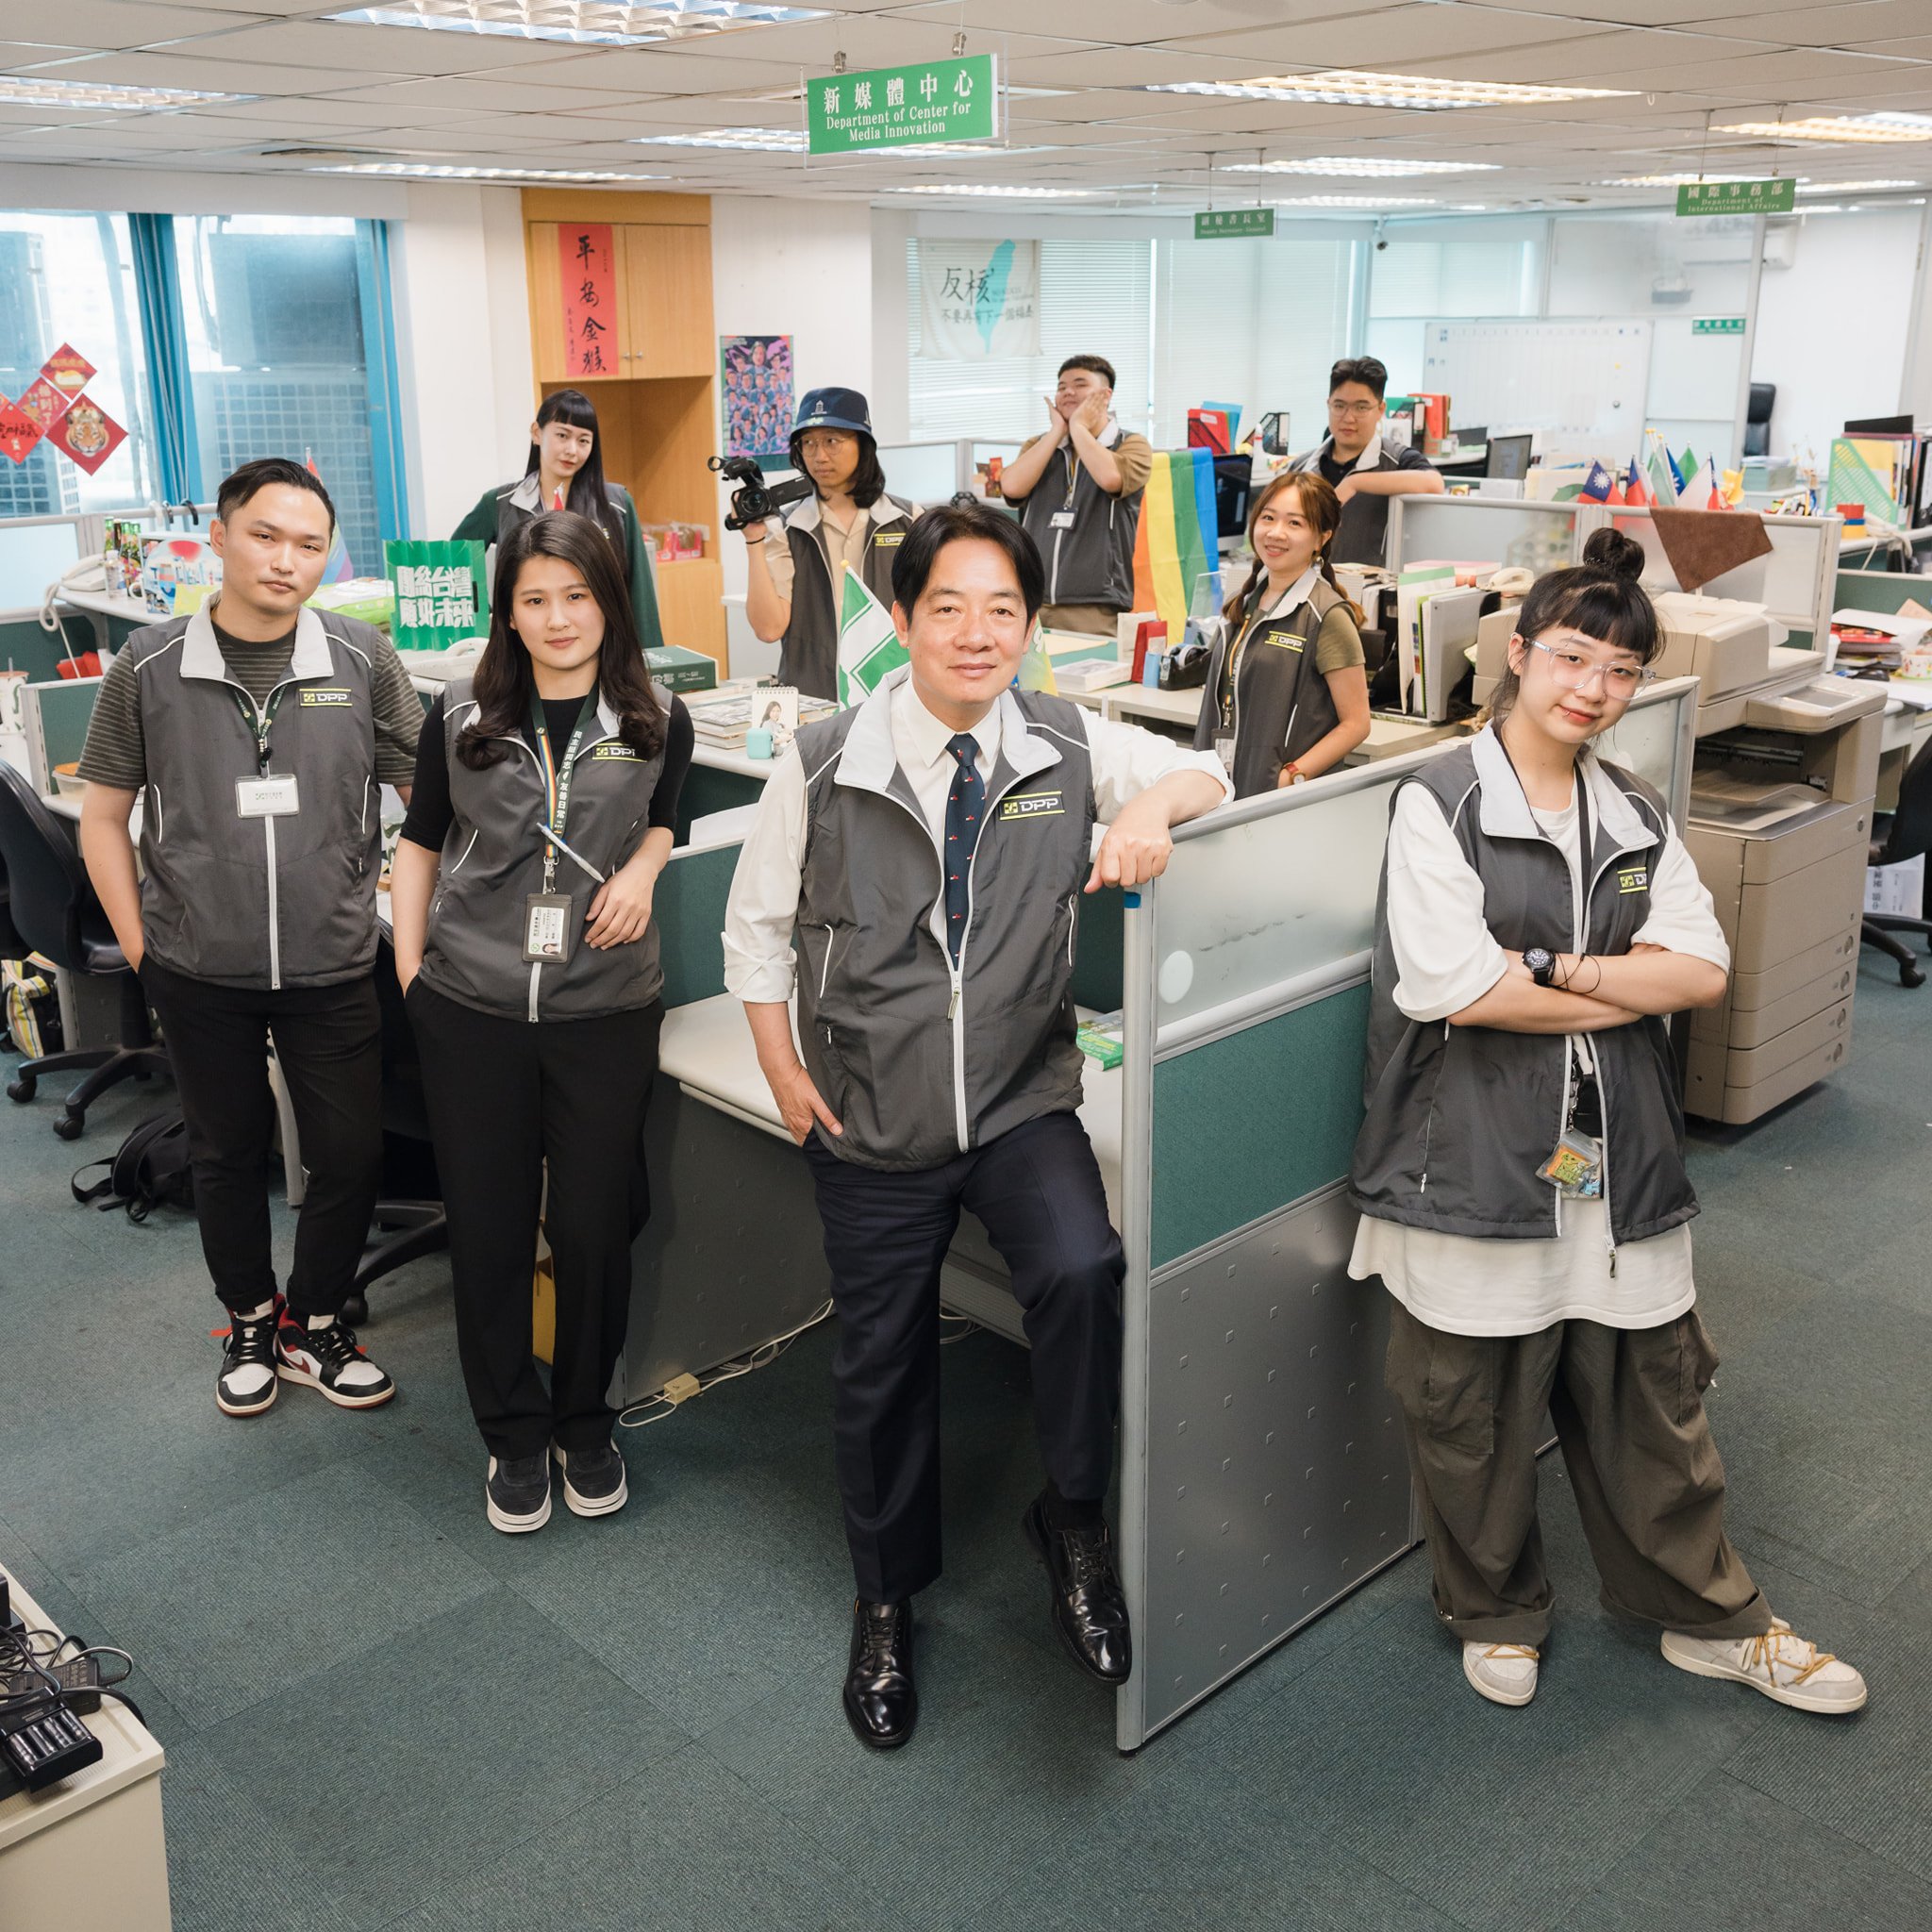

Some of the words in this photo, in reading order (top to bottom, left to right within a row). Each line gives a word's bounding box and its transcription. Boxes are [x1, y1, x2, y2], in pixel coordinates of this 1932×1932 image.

[824, 70, 974, 114] 新媒體中心
[826, 112, 890, 130] Department
[893, 108, 906, 123] of
[909, 105, 947, 120] Center
[952, 101, 971, 116] for
[849, 125, 880, 142] Media
[885, 121, 945, 138] Innovation
[940, 268, 995, 306] 反核
[1278, 636, 1303, 647] DPP
[316, 693, 348, 702] DPP
[1019, 797, 1058, 812] DPP
